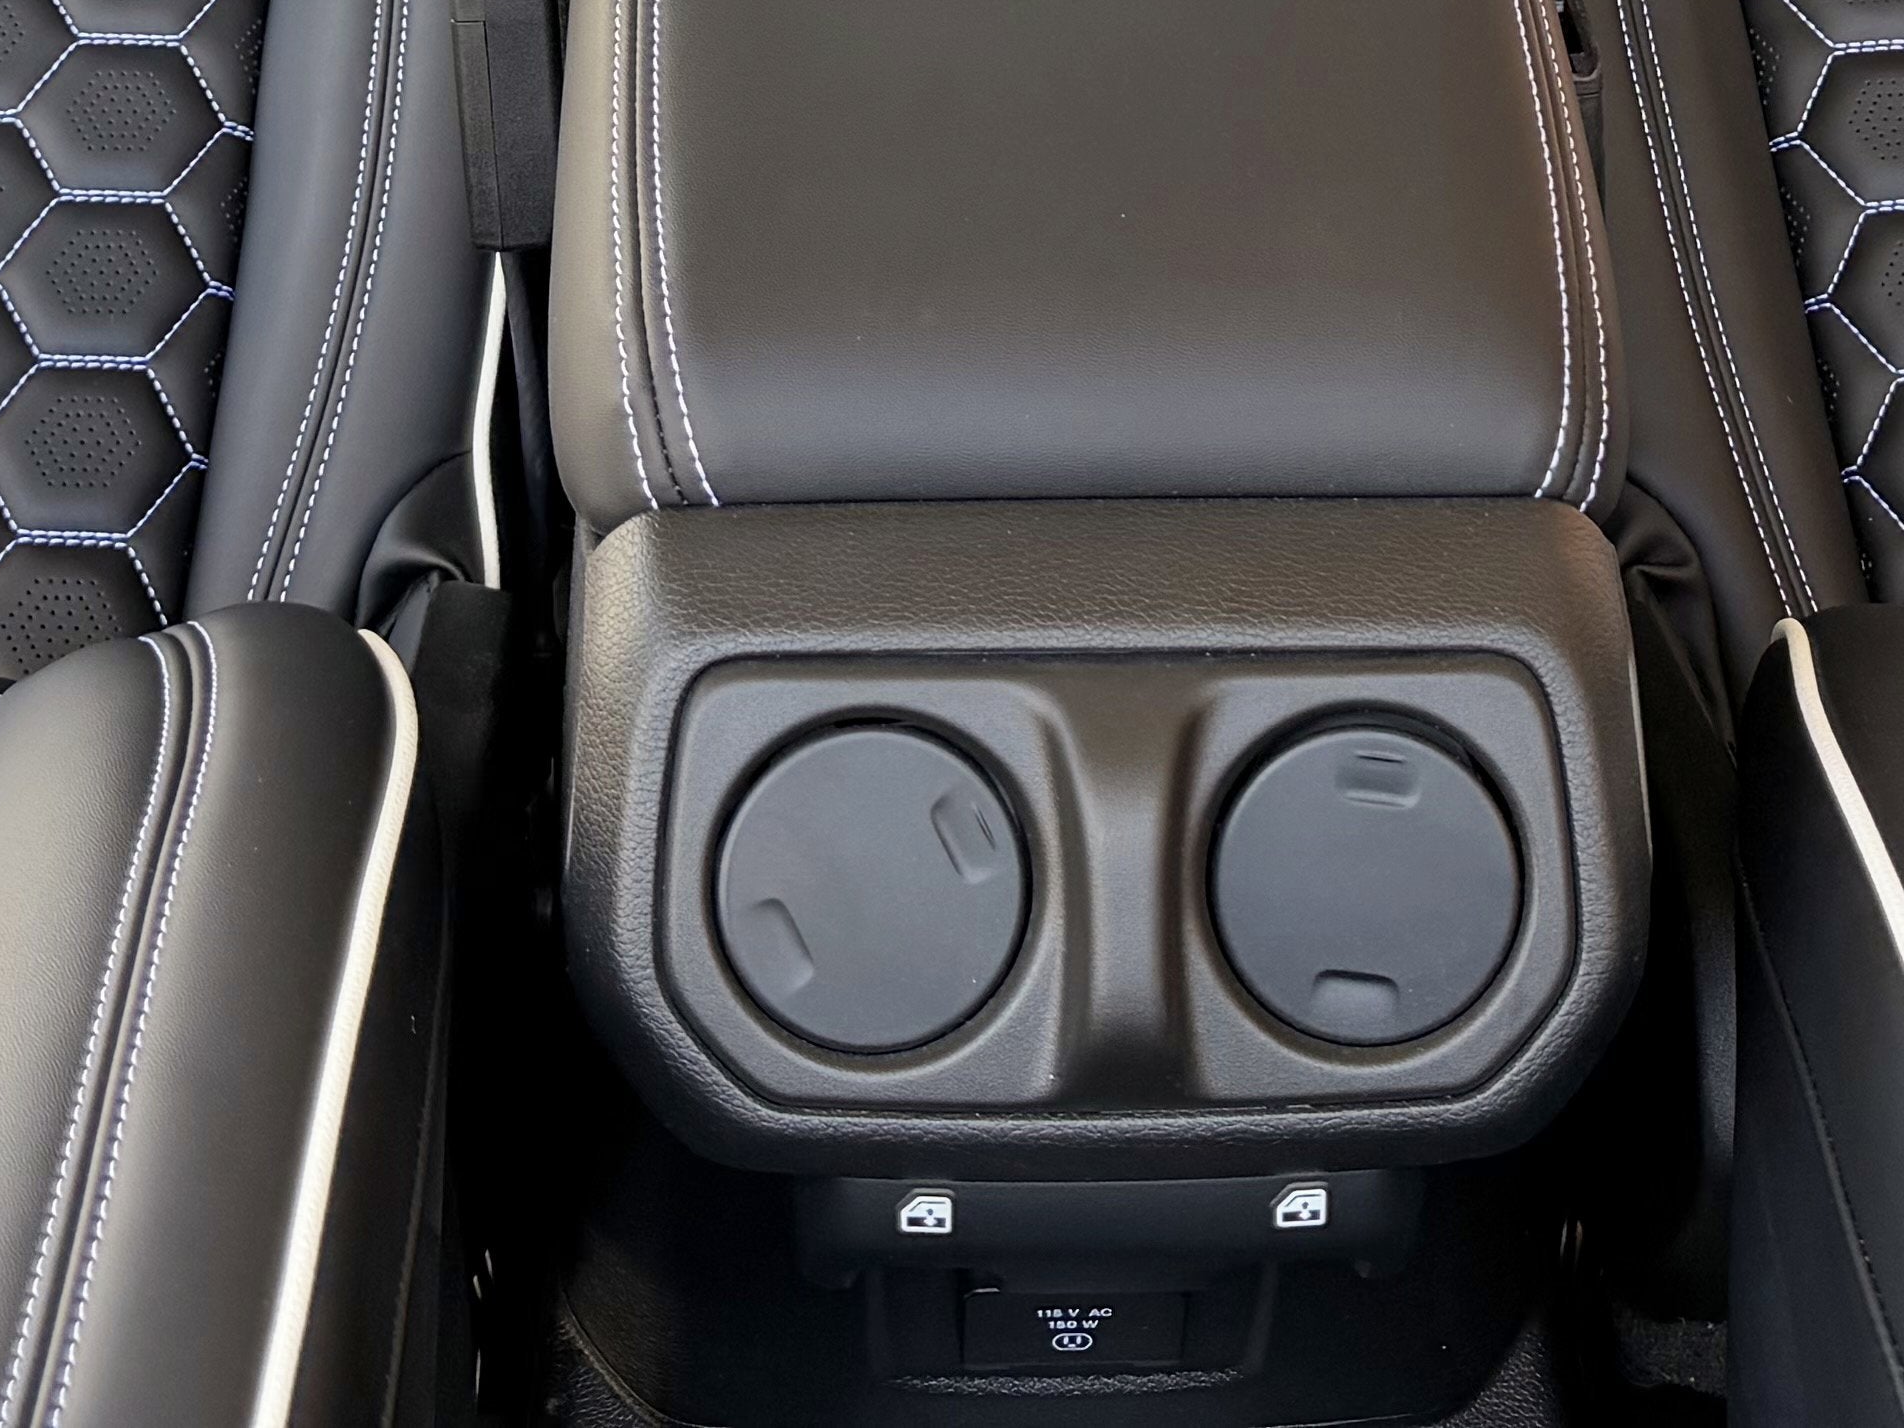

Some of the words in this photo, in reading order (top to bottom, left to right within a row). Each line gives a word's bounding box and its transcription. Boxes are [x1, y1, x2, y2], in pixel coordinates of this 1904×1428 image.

[1068, 1308, 1080, 1317] V
[1088, 1308, 1113, 1317] AC
[1082, 1319, 1099, 1329] W
